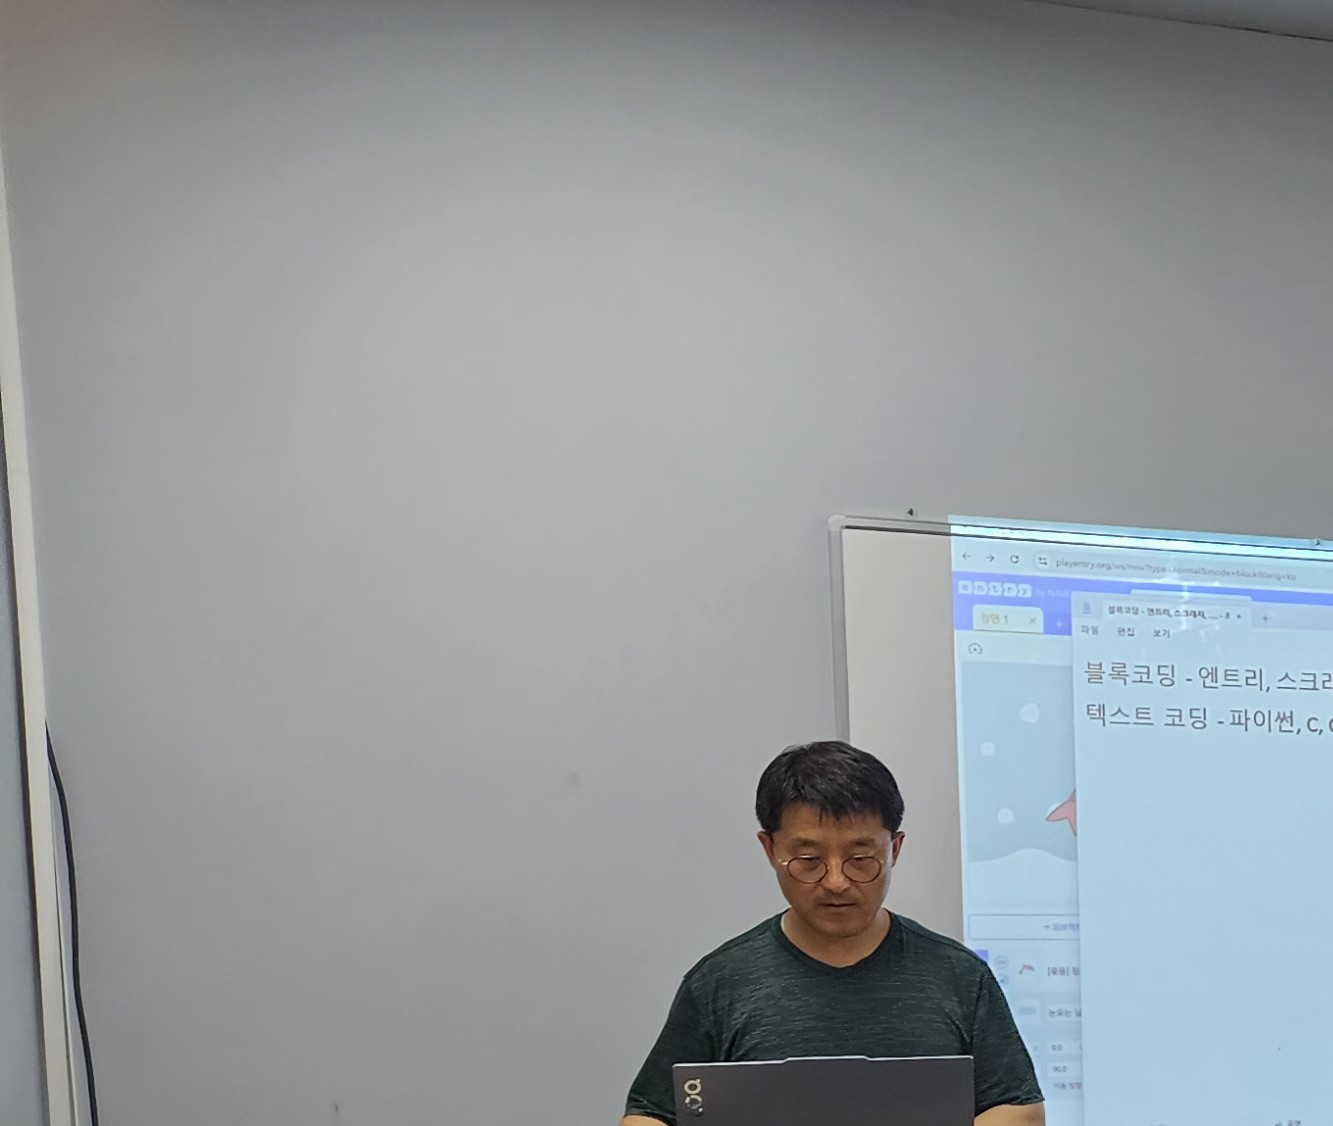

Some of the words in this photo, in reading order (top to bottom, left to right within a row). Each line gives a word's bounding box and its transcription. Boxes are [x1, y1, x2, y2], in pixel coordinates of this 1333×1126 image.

[1085, 662, 1175, 687] 블록코딩
[1199, 667, 1270, 692] 엔트리,
[1087, 704, 1154, 727] 텍스트
[1164, 708, 1206, 729] 코딩
[1230, 709, 1301, 735] 파이썬,
[1307, 717, 1323, 735] C,
